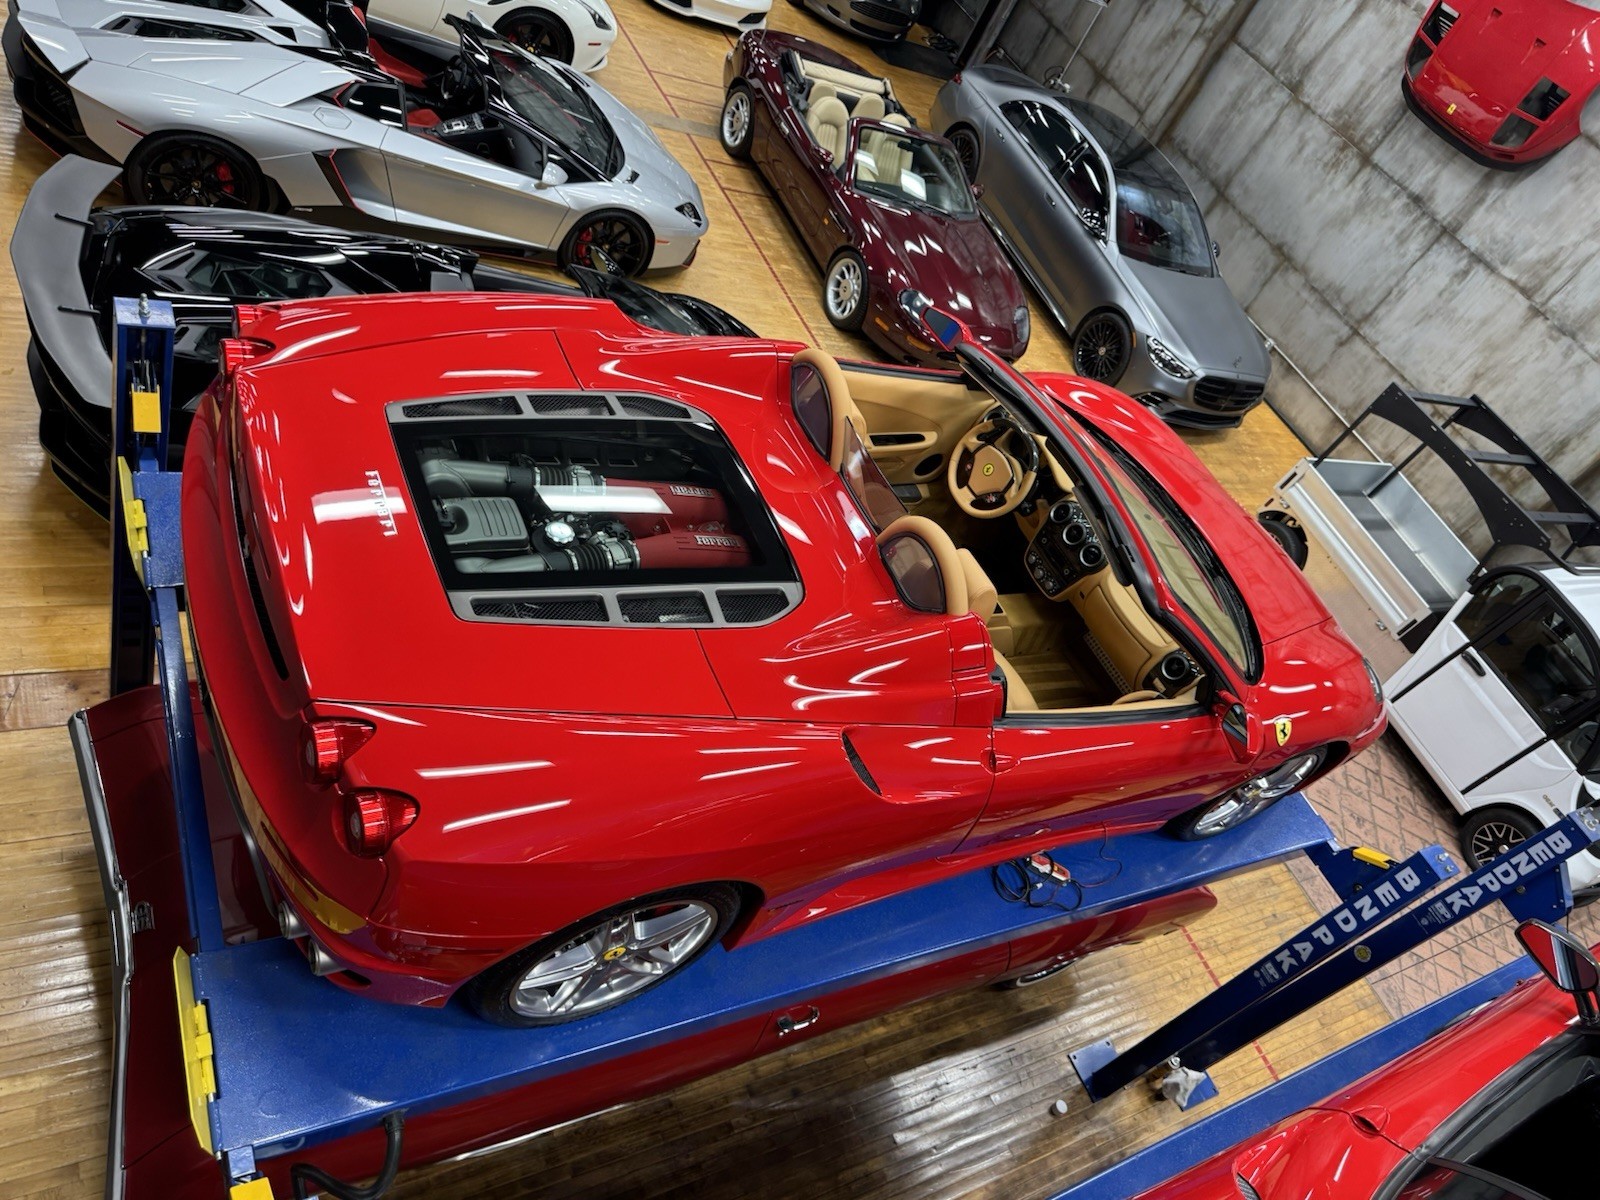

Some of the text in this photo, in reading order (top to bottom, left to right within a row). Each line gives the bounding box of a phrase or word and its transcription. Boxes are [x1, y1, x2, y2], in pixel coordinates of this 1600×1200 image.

[365, 470, 398, 536] Ferrari
[694, 534, 741, 547] Ferrari
[1444, 830, 1572, 915] BENDPAK
[1275, 866, 1421, 975] BENDPAK
